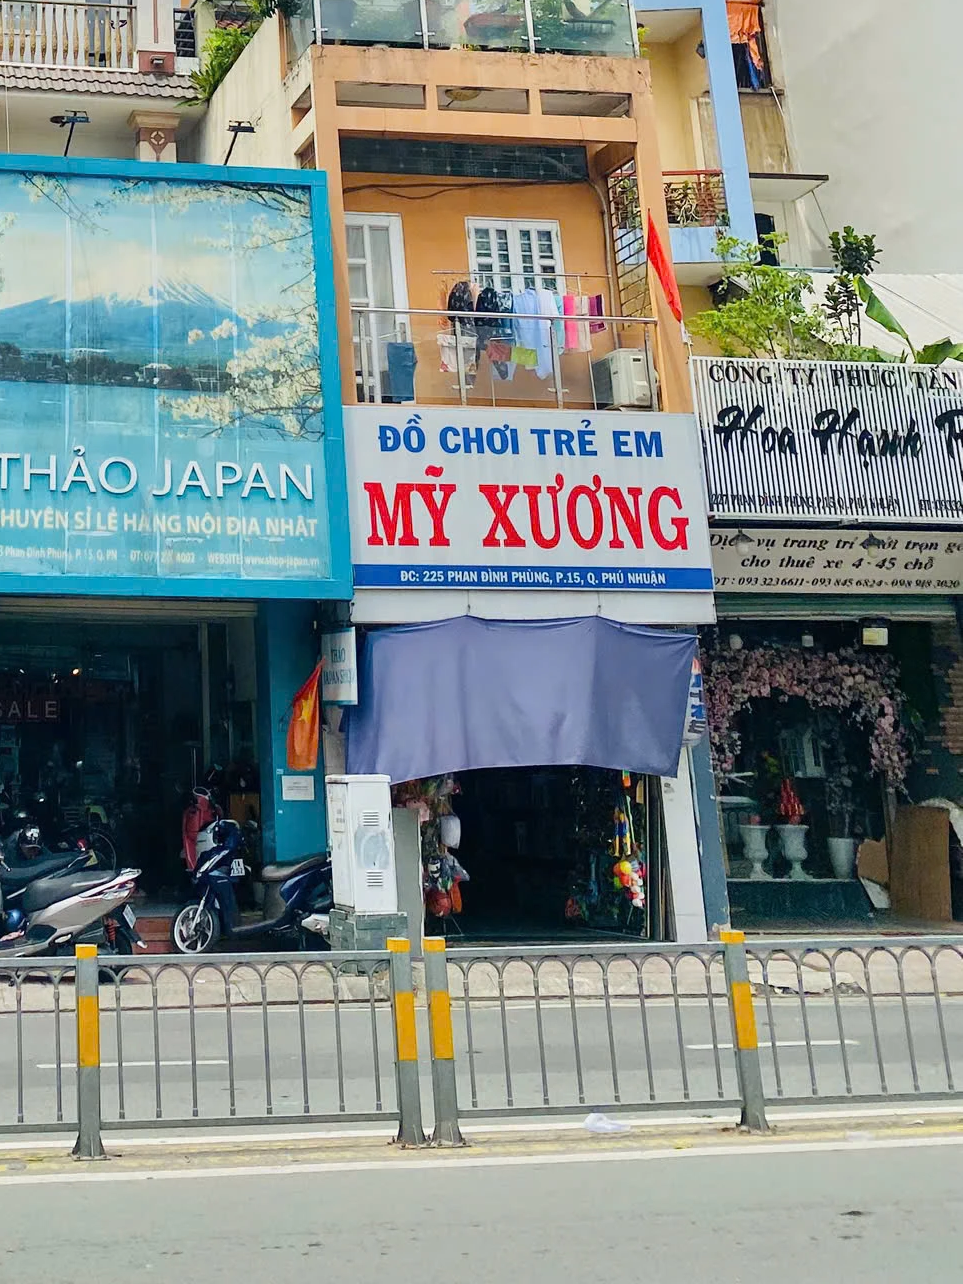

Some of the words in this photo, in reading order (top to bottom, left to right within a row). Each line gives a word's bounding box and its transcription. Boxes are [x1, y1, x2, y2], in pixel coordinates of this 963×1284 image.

[709, 361, 773, 385] CÔNG
[784, 366, 816, 386] TY
[832, 364, 896, 387] PHÚC
[378, 413, 426, 454] ĐỒ
[439, 424, 520, 455] CHƠI
[531, 419, 598, 457] TRẺ
[613, 430, 664, 458] EM
[714, 404, 798, 456] Hoa
[811, 406, 925, 470] Hạnh
[152, 458, 314, 500] JAPAN
[363, 465, 456, 547] MỸ
[479, 473, 690, 551] XƯƠNG
[187, 512, 221, 539] NỘI
[757, 538, 776, 551] vụ
[783, 537, 829, 551] trang
[836, 536, 859, 550] trí
[741, 555, 771, 568] cho
[779, 556, 815, 569] thuê
[823, 559, 843, 569] xe
[400, 571, 419, 582] ĐC:
[423, 571, 444, 583] 225
[448, 571, 477, 583] PHAN
[481, 568, 508, 583] ĐÌNH
[512, 569, 553, 585] PHÙNG,
[555, 571, 584, 585] P.15,
[587, 572, 599, 586] Q.
[602, 570, 624, 584] PHÚ
[628, 570, 666, 587] NHUẬN
